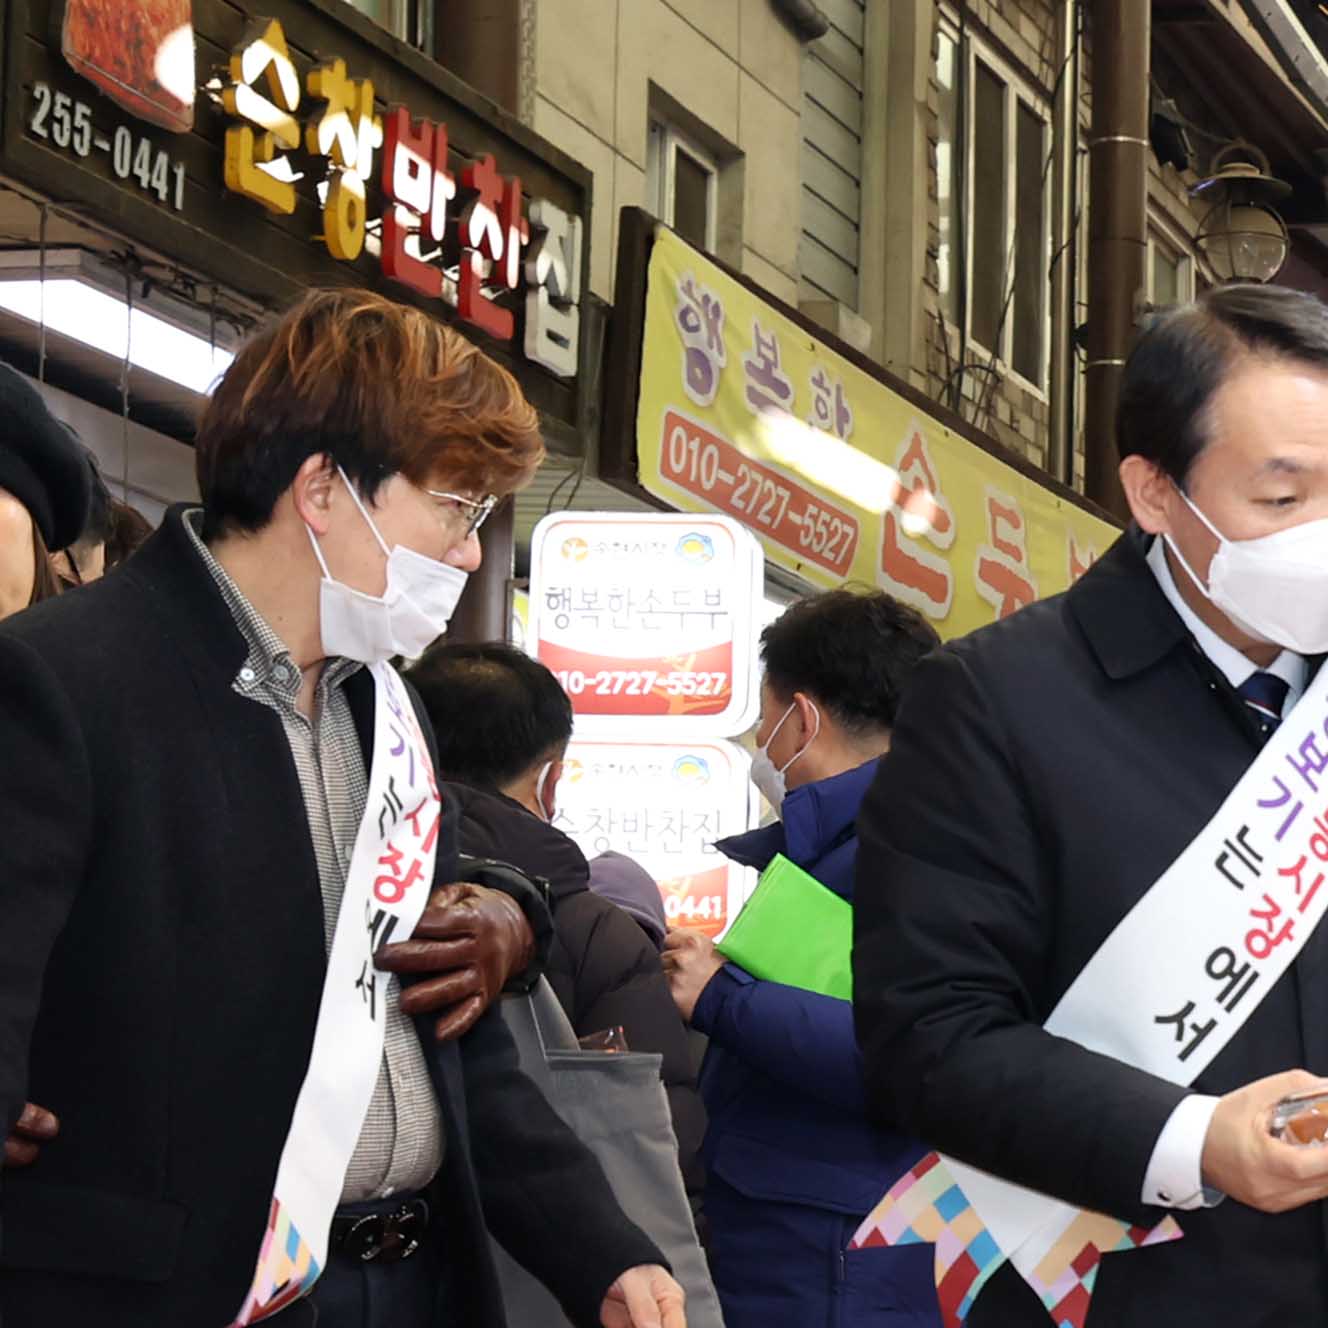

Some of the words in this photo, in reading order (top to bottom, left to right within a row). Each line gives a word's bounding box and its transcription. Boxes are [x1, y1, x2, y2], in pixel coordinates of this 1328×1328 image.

[30, 82, 186, 212] 255-0441
[222, 15, 583, 378] 순창반찬집
[668, 424, 856, 567] 010-2727-5527
[880, 430, 1098, 617] 손두
[555, 670, 728, 695] 10-2727-5527
